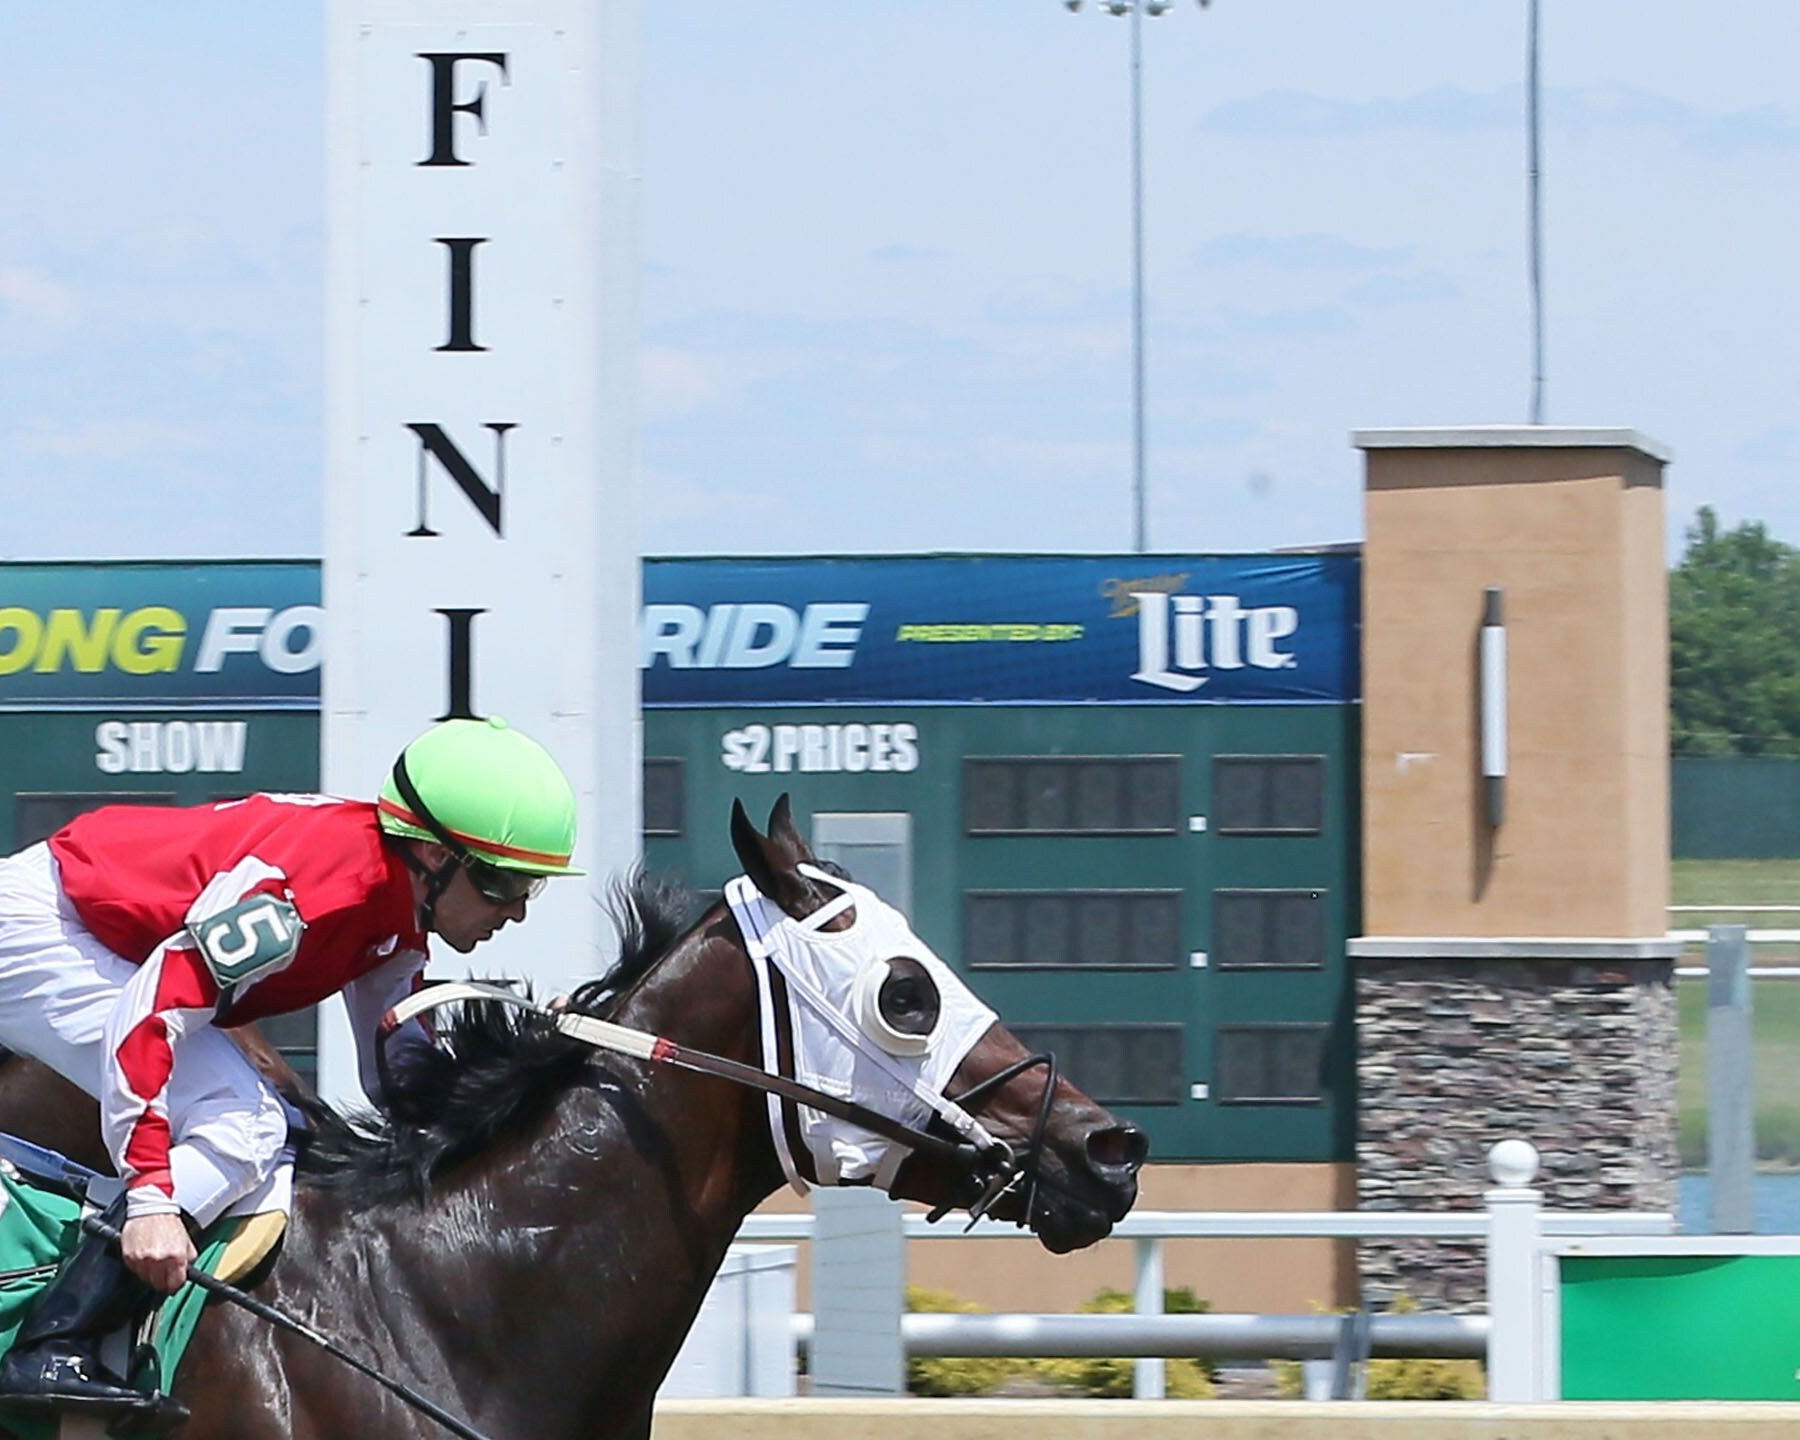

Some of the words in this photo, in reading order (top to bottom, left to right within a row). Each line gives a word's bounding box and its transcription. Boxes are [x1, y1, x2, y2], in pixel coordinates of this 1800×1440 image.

[401, 51, 522, 722] FINI
[193, 604, 325, 674] FO
[636, 603, 871, 668] RIDE
[897, 623, 1040, 642] PRESENTED
[1129, 592, 1299, 692] Lite
[94, 720, 249, 774] SHOW
[772, 723, 920, 773] PRICES
[205, 903, 291, 967] 5
